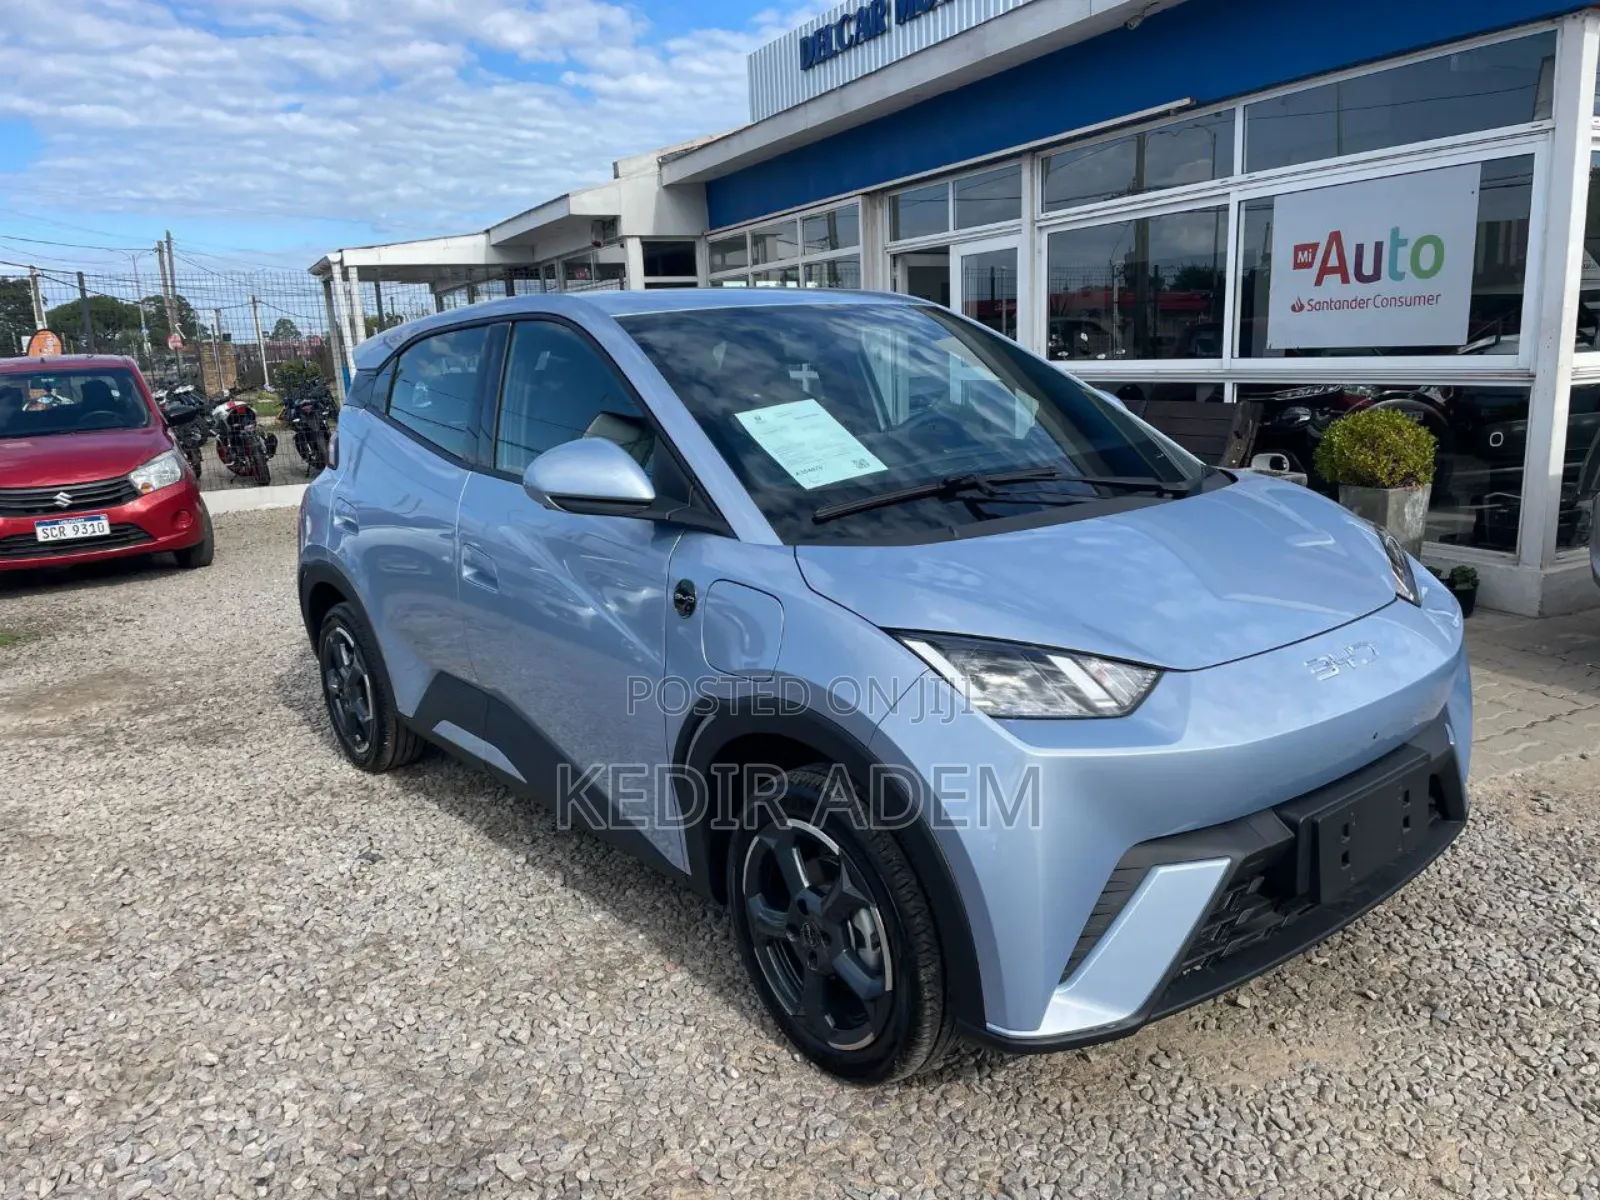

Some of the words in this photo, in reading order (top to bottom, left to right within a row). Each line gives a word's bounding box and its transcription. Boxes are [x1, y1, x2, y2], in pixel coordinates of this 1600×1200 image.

[1314, 226, 1445, 287] Auto
[1307, 295, 1371, 312] Santander
[1373, 293, 1442, 309] Consumer
[42, 526, 66, 539] SCR
[72, 522, 105, 535] 9310
[1303, 641, 1380, 681] BYD
